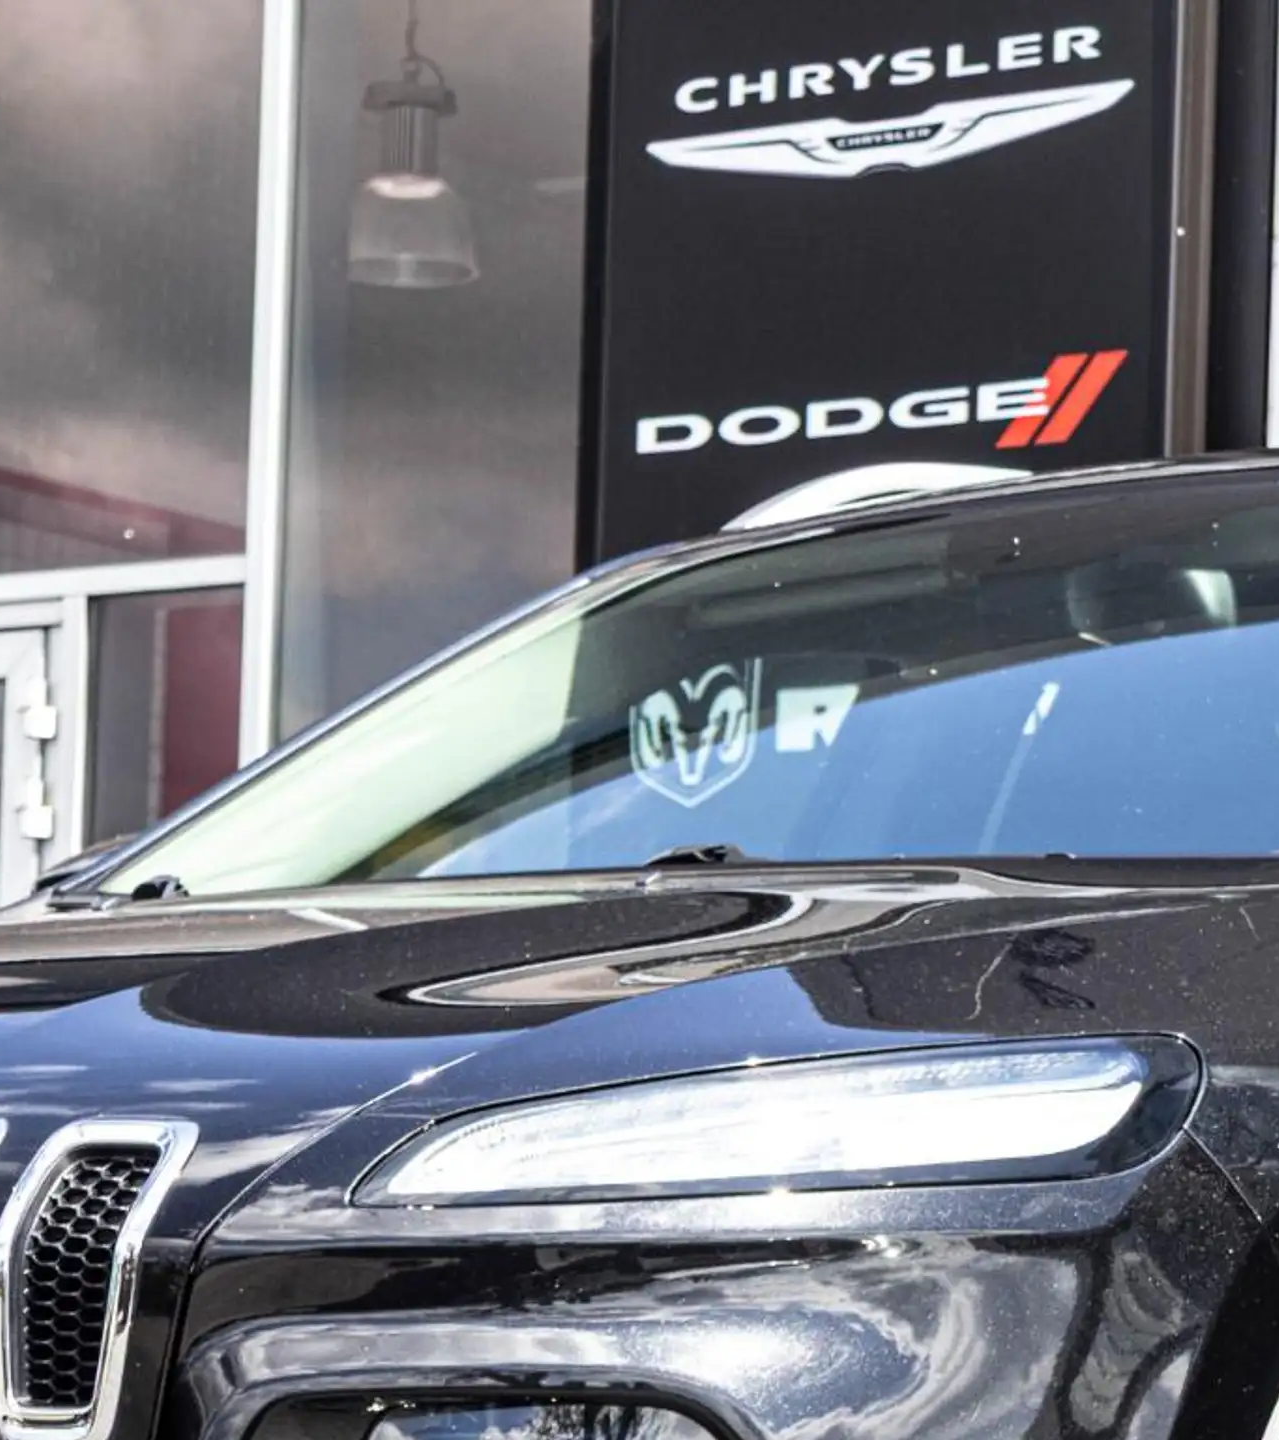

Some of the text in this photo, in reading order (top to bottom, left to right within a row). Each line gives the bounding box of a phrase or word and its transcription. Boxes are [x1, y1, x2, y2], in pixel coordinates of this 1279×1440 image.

[674, 25, 1103, 113] CHRYSLER
[836, 127, 931, 149] CHRYSLER
[635, 377, 1051, 455] DODGE
